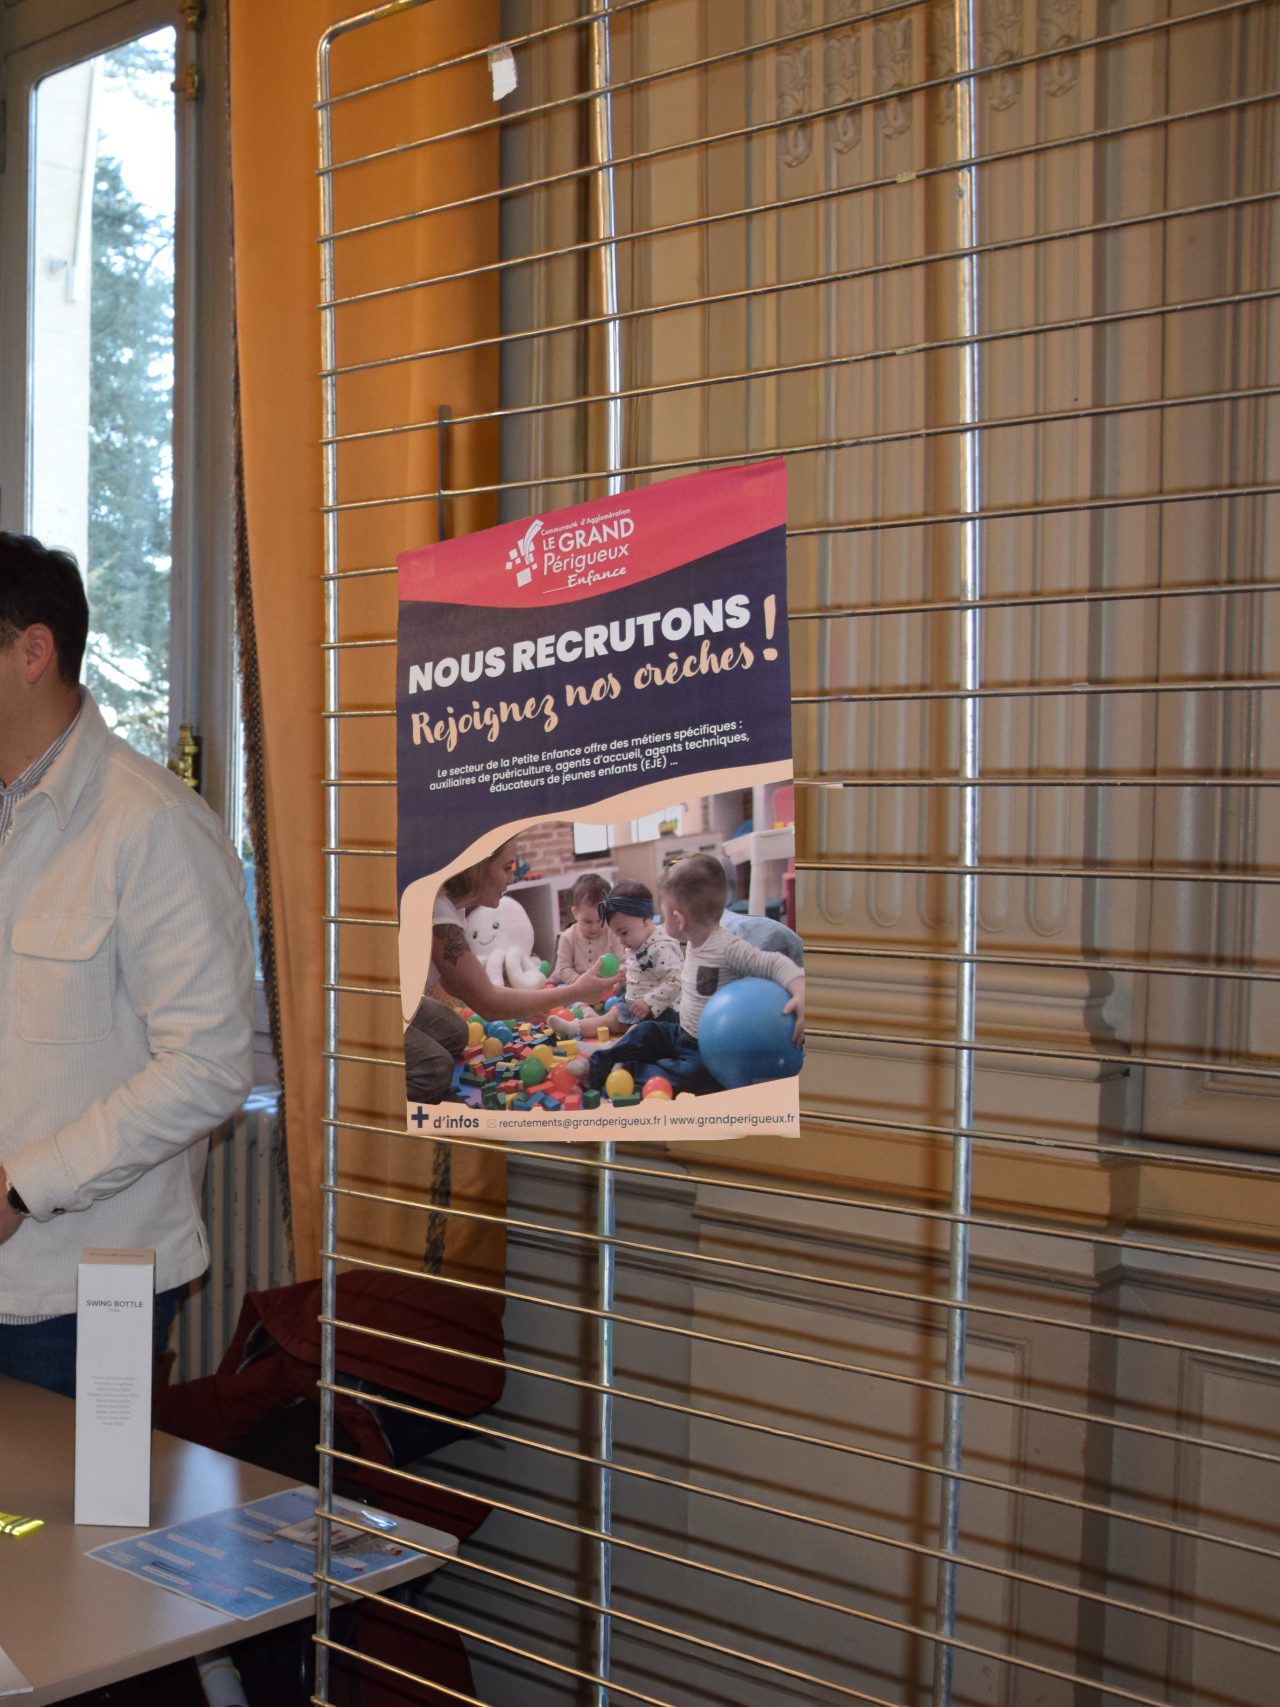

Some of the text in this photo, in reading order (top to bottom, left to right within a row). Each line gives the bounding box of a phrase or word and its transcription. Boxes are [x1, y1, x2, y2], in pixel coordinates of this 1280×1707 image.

[540, 508, 631, 536] Communauté d'Agglomération
[543, 518, 635, 552] LE GRAND
[543, 544, 629, 576] Périgueux
[567, 566, 627, 588] Enfance
[408, 593, 751, 695] NOUS RECRUTONS
[411, 593, 779, 752] Rejoignez nos crèches !
[429, 732, 750, 791] auxiliaires de puériculture, agents d'accueil, agents techniques,
[437, 768, 447, 778] Le
[449, 763, 484, 776] secteur
[486, 759, 499, 770] de
[501, 758, 510, 768] la
[512, 753, 540, 766] Petite
[541, 746, 582, 761] Enfance
[584, 742, 607, 754] offre
[610, 740, 629, 750] des
[631, 733, 671, 747] métiers
[673, 721, 737, 741] spécifiques
[489, 776, 545, 793] éducateurs
[547, 774, 560, 785] de
[562, 770, 595, 785] jeunes
[598, 762, 638, 776] enfants
[640, 755, 667, 772] (EJE)
[433, 1115, 480, 1129] d'infos
[499, 1115, 661, 1129] recrutements@grandperigueux.fr
[669, 1113, 795, 1127] www.grandperigueux.fr
